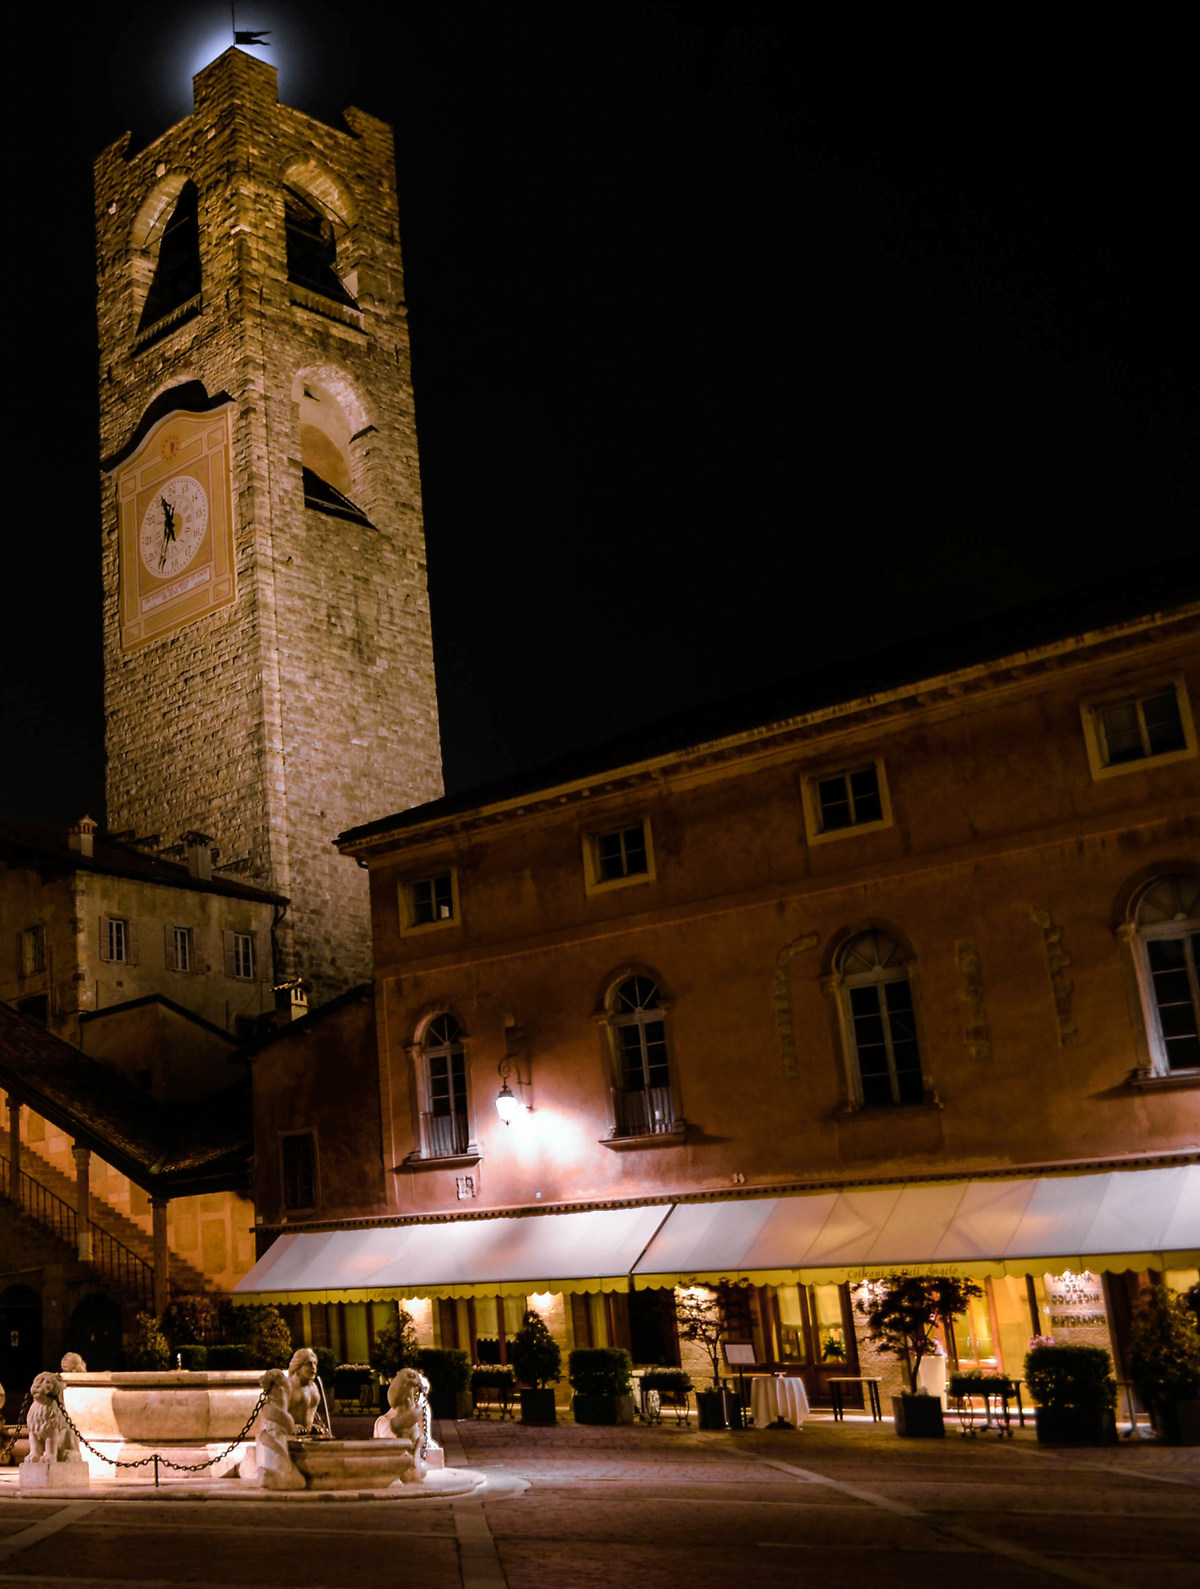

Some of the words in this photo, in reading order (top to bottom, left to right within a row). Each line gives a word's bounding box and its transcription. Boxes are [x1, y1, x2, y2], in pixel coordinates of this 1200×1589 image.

[847, 1267, 884, 1279] Colleoni
[927, 1263, 958, 1276] Angelo
[1065, 1284, 1084, 1293] DEL
